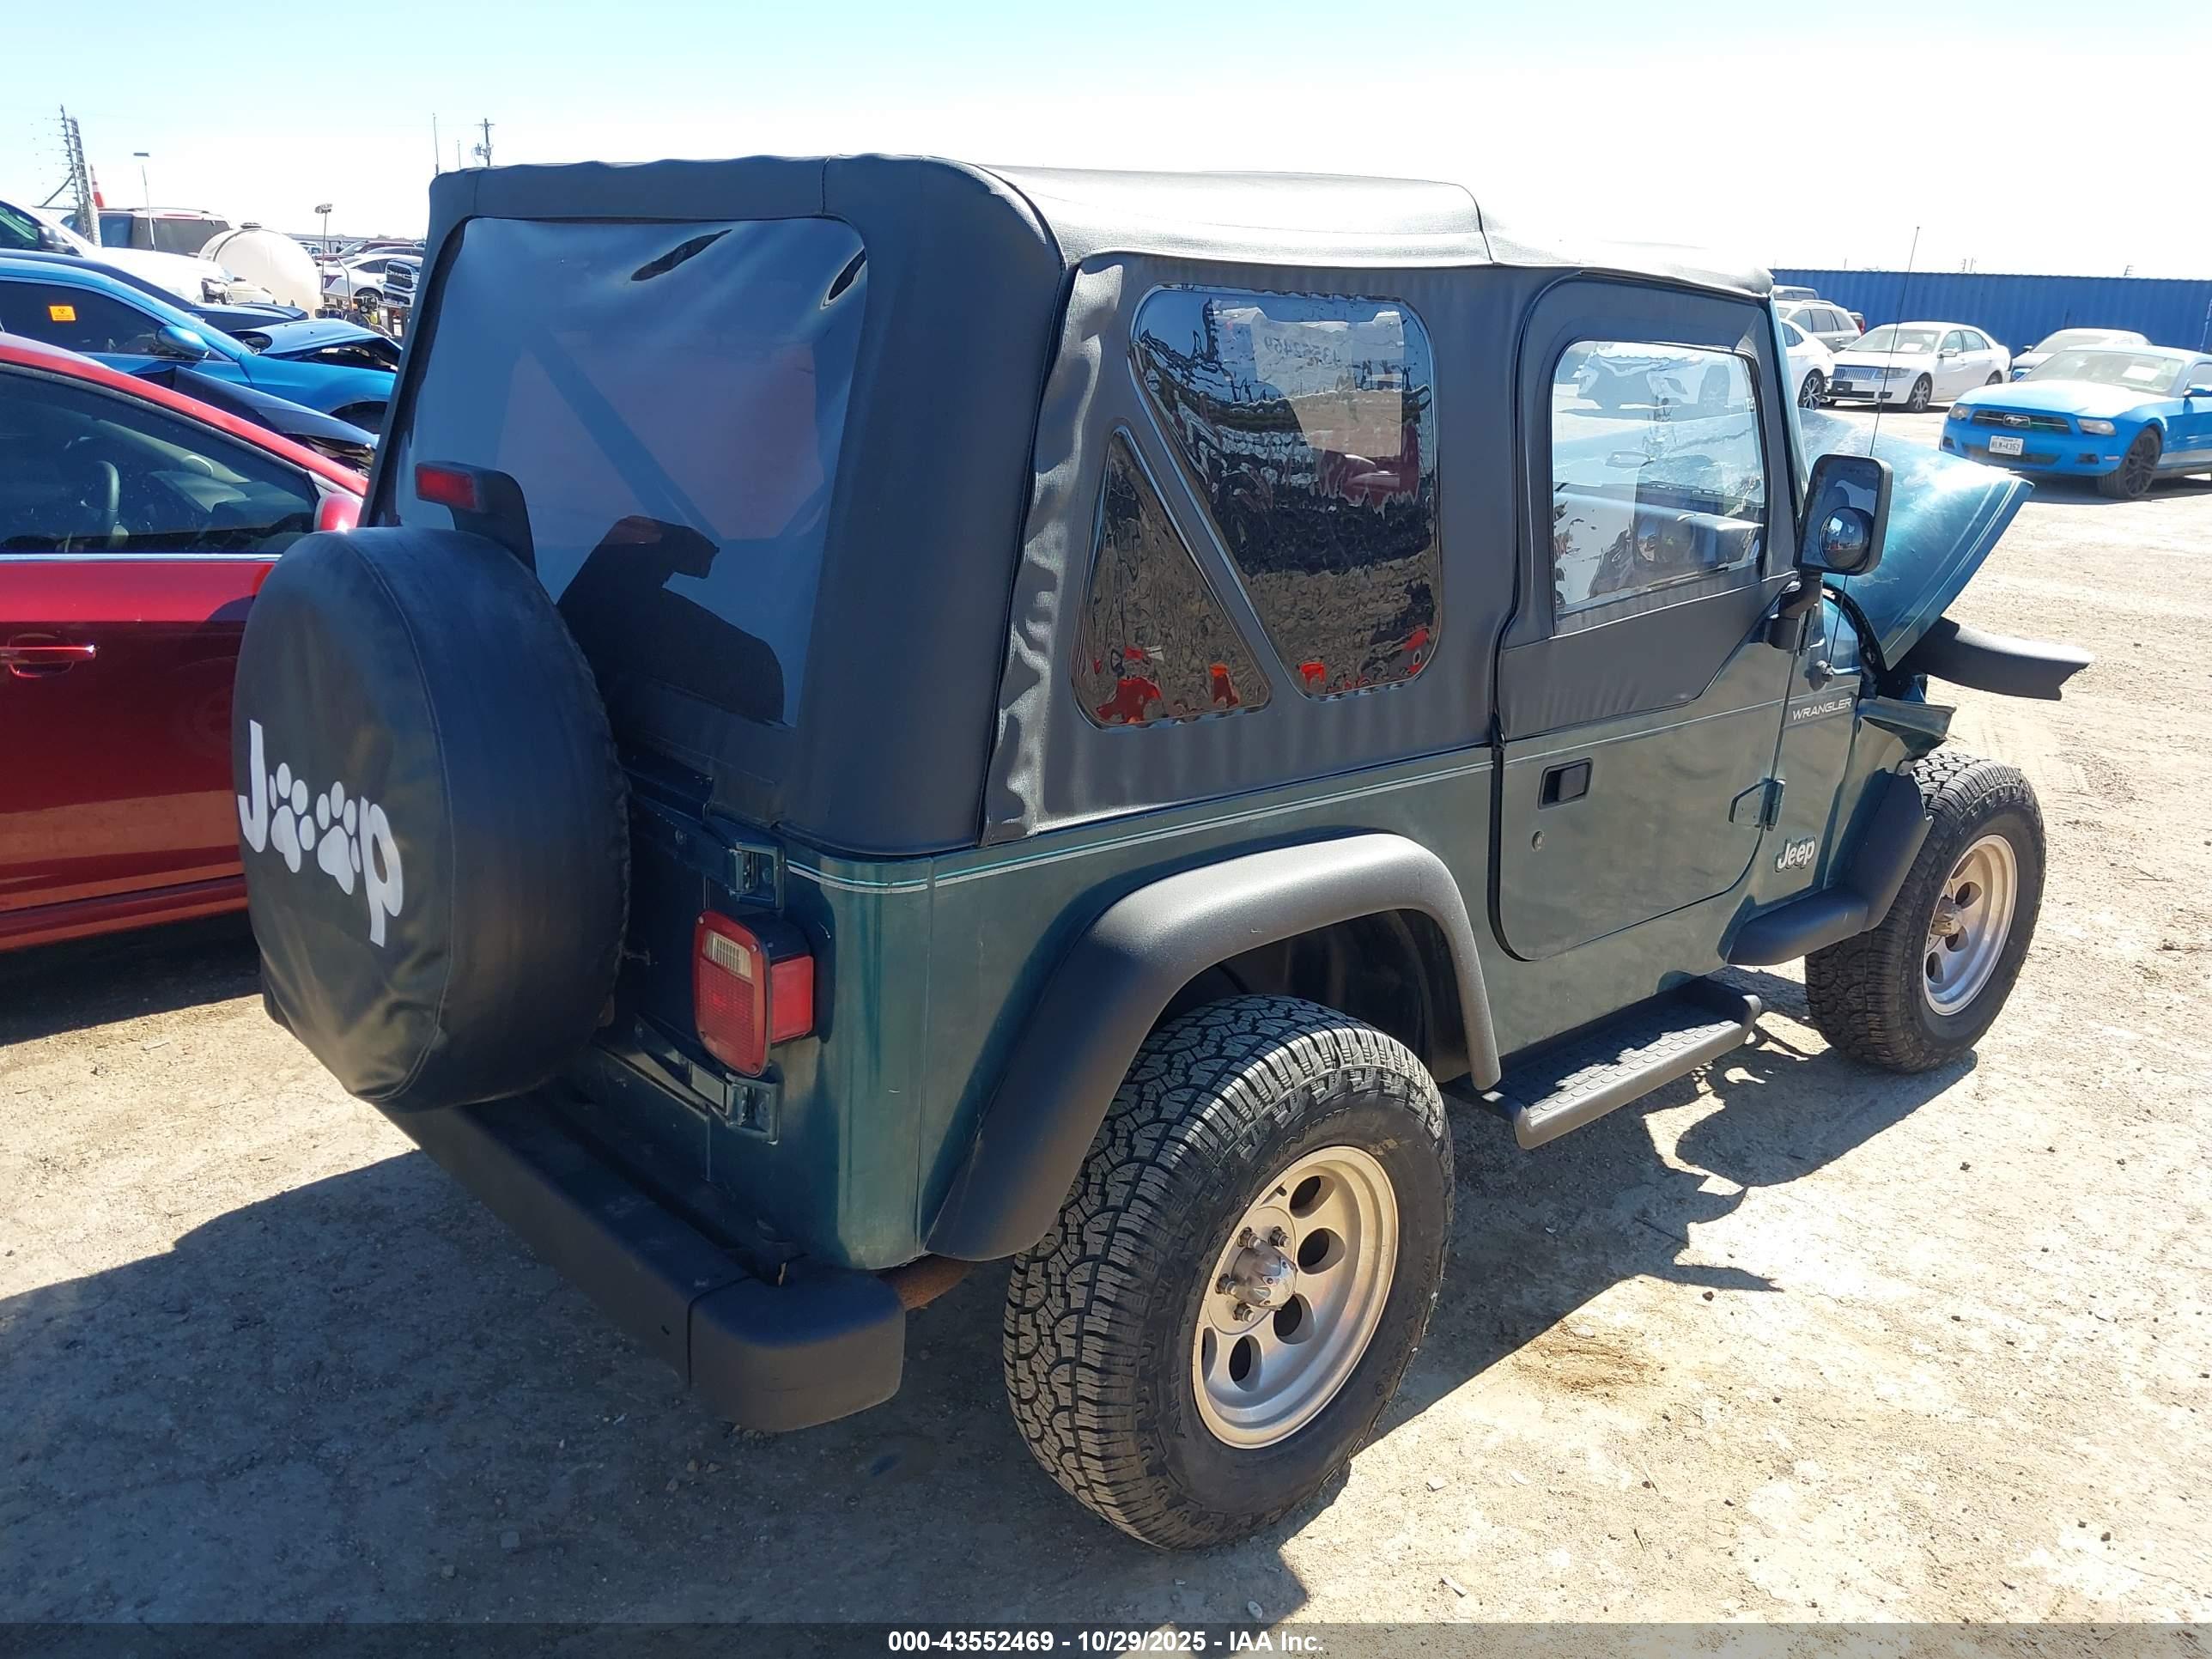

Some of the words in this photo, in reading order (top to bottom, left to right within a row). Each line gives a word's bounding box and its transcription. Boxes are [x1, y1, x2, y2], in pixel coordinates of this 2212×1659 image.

[1792, 697, 1852, 720] WRANGLER
[237, 720, 404, 948] Jp
[1776, 838, 1815, 871] Jeep
